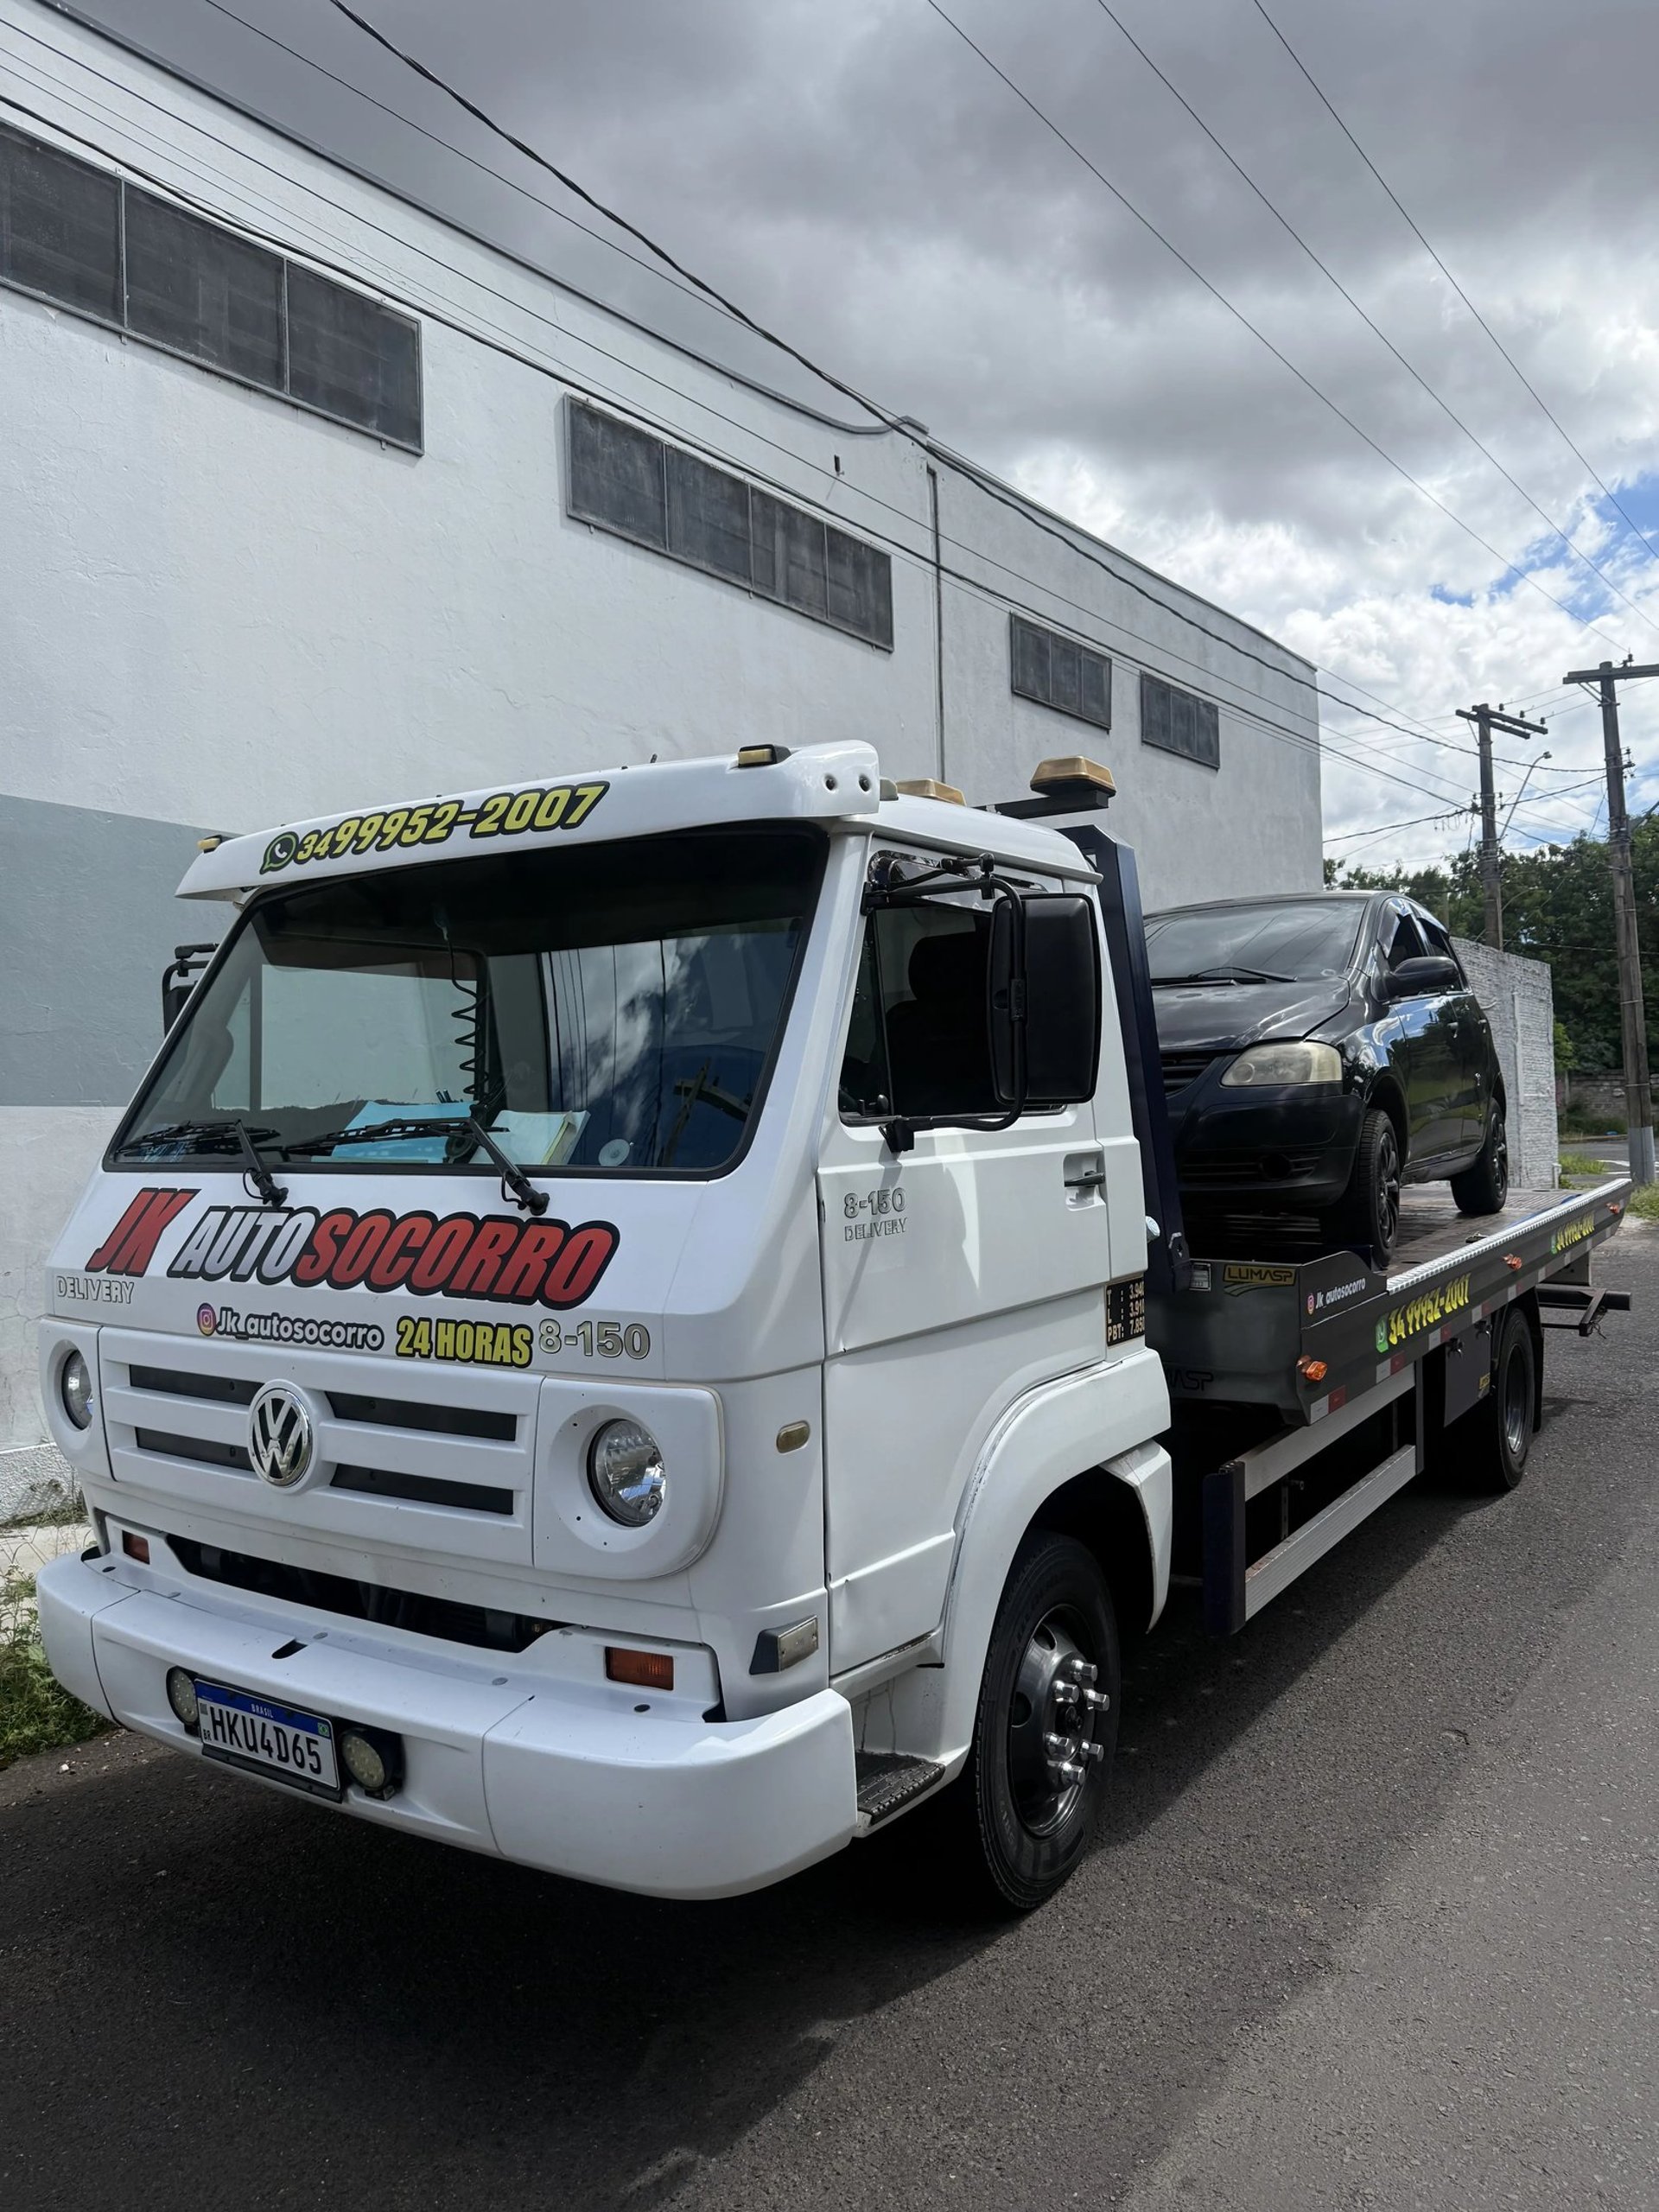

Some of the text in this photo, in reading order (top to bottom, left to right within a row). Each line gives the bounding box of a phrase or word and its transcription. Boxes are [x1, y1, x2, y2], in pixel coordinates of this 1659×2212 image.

[844, 1188, 906, 1218] 8-150
[844, 1217, 907, 1242] DELIVERY
[85, 1188, 620, 1309] JK AUTOSOCORRO
[56, 1275, 135, 1305] DELIVERY
[1227, 1267, 1294, 1283] LUMASP
[1315, 1277, 1366, 1309] Jk_autosocorro
[1389, 1272, 1471, 1344] 34 99952-2007
[217, 1307, 384, 1350] Jk_autosocorro
[397, 1316, 533, 1368] 24 HORAS
[537, 1318, 652, 1360] 8-150
[250, 1703, 274, 1719] BRASIL
[210, 1706, 322, 1775] HKU4D65
